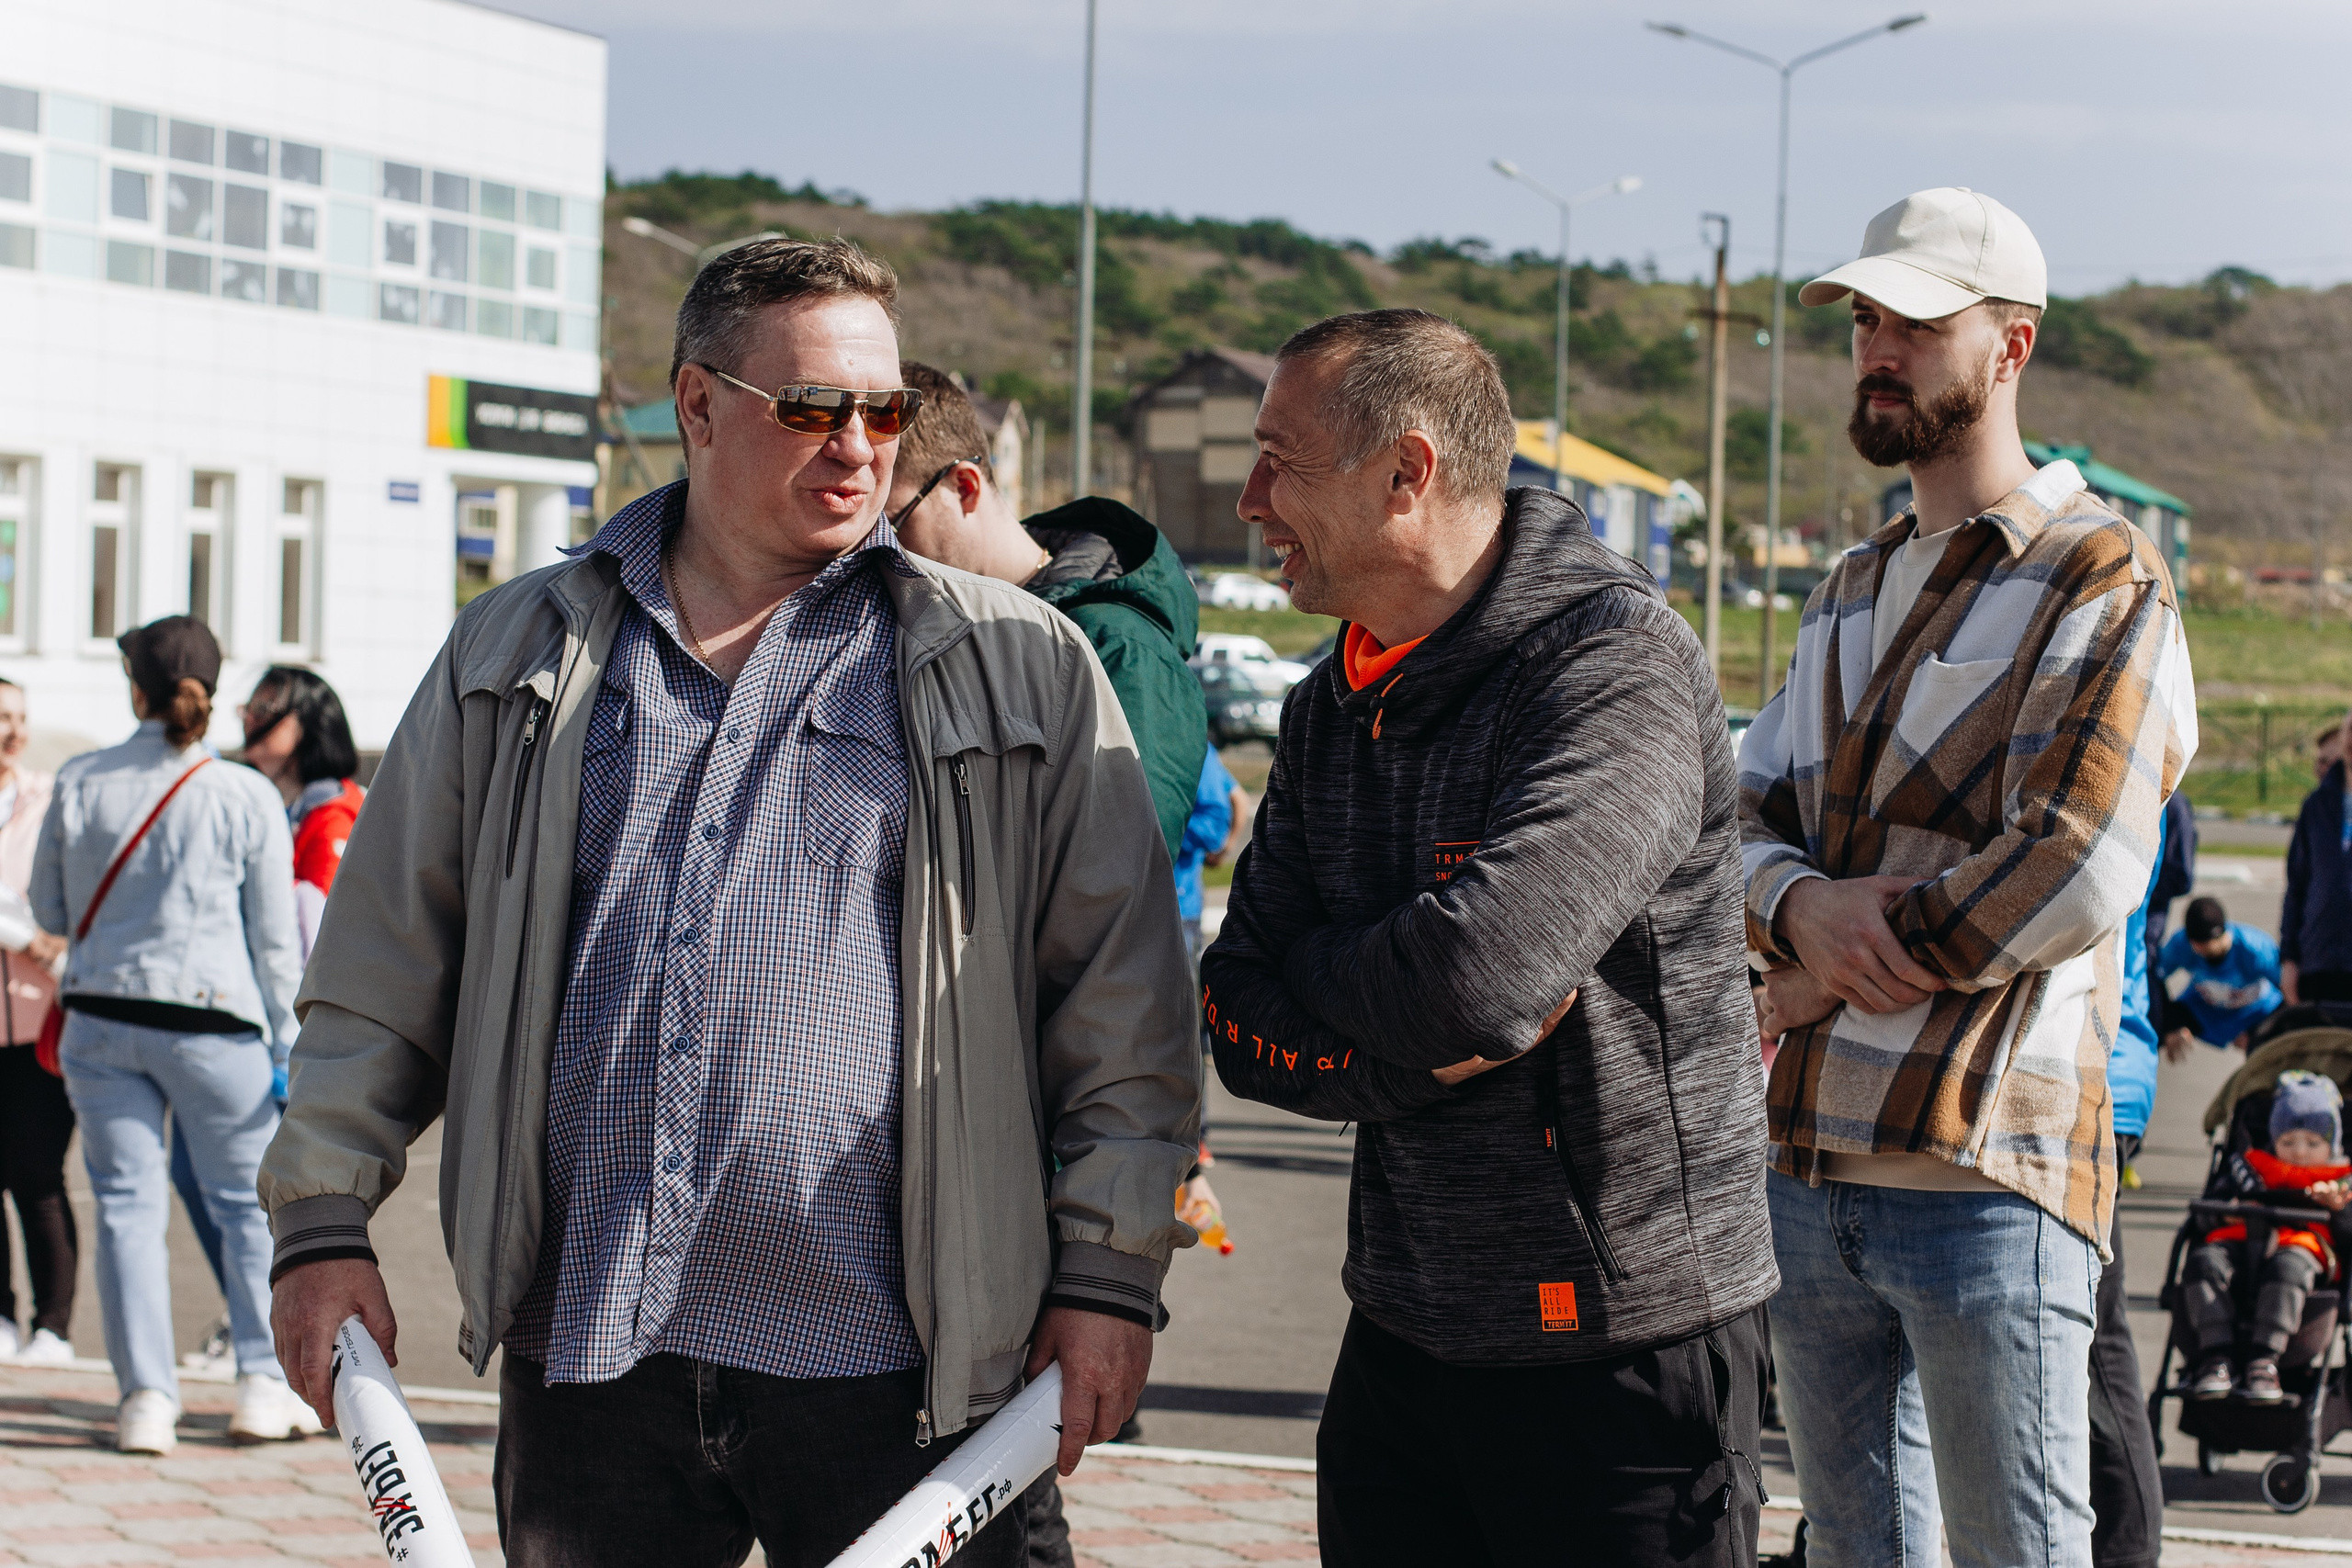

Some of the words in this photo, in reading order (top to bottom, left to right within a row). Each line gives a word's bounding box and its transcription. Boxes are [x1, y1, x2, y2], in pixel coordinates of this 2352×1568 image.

[1252, 1034, 1298, 1071] ALL
[1543, 1288, 1560, 1296] IT'S
[1544, 1297, 1560, 1305] ALL
[1544, 1306, 1568, 1315] RIDE
[341, 1325, 356, 1349] ГЕРОЕВ
[348, 1348, 362, 1368] ЛИГА
